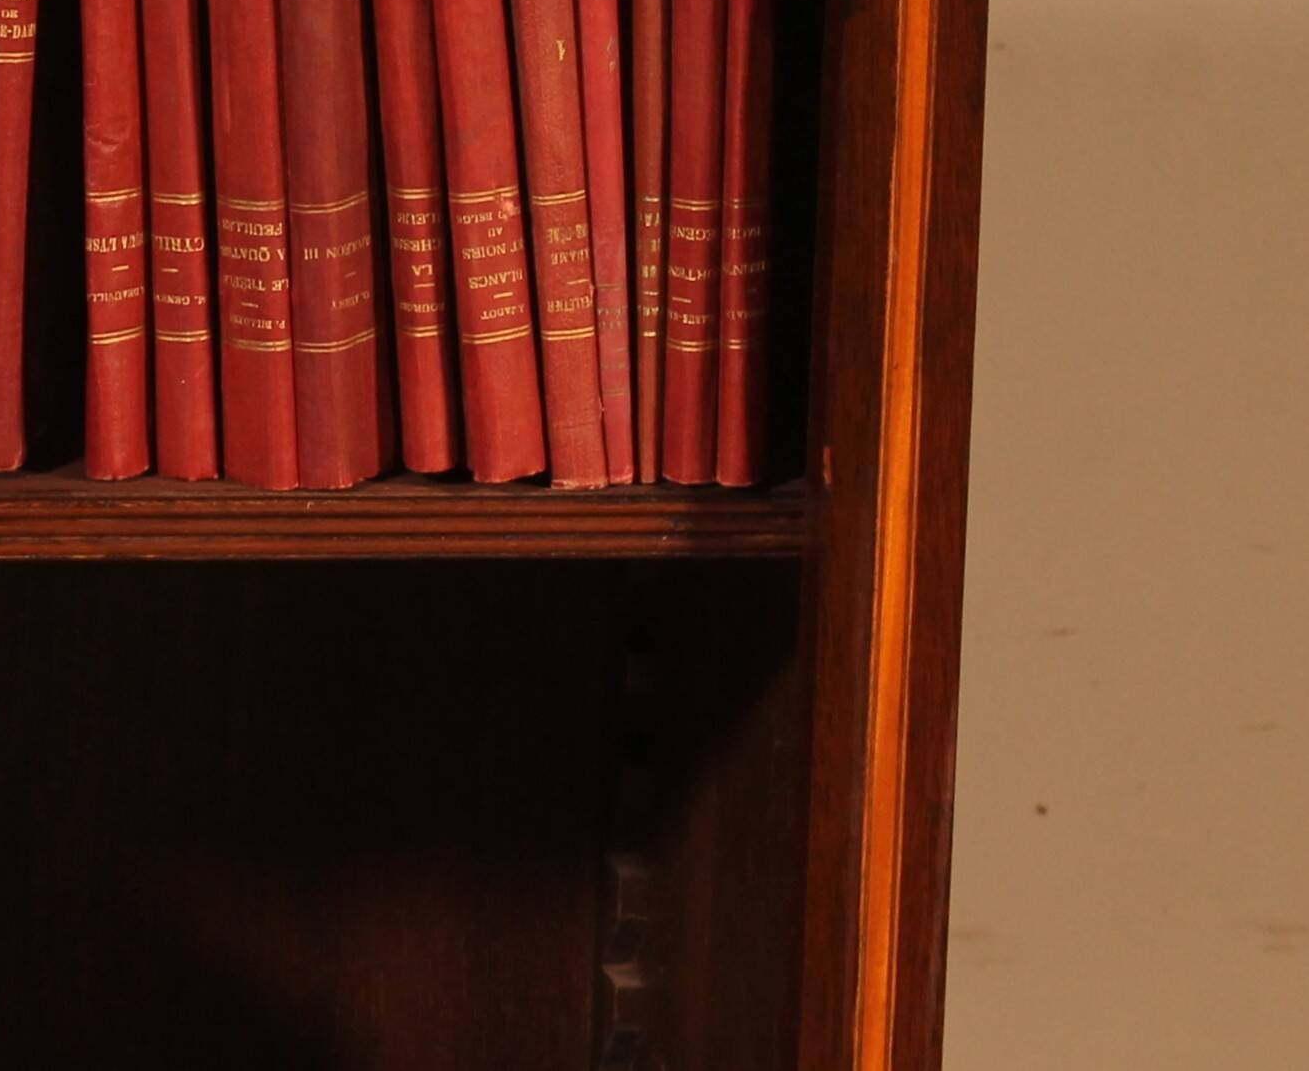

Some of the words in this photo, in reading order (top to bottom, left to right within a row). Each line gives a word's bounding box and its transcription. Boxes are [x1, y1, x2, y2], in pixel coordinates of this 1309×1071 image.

[487, 227, 503, 237] AU
[153, 235, 204, 252] CYRIL
[462, 242, 507, 260] NOIRS
[304, 248, 319, 261] III
[411, 264, 433, 276] LA
[468, 268, 523, 289] BLANCS
